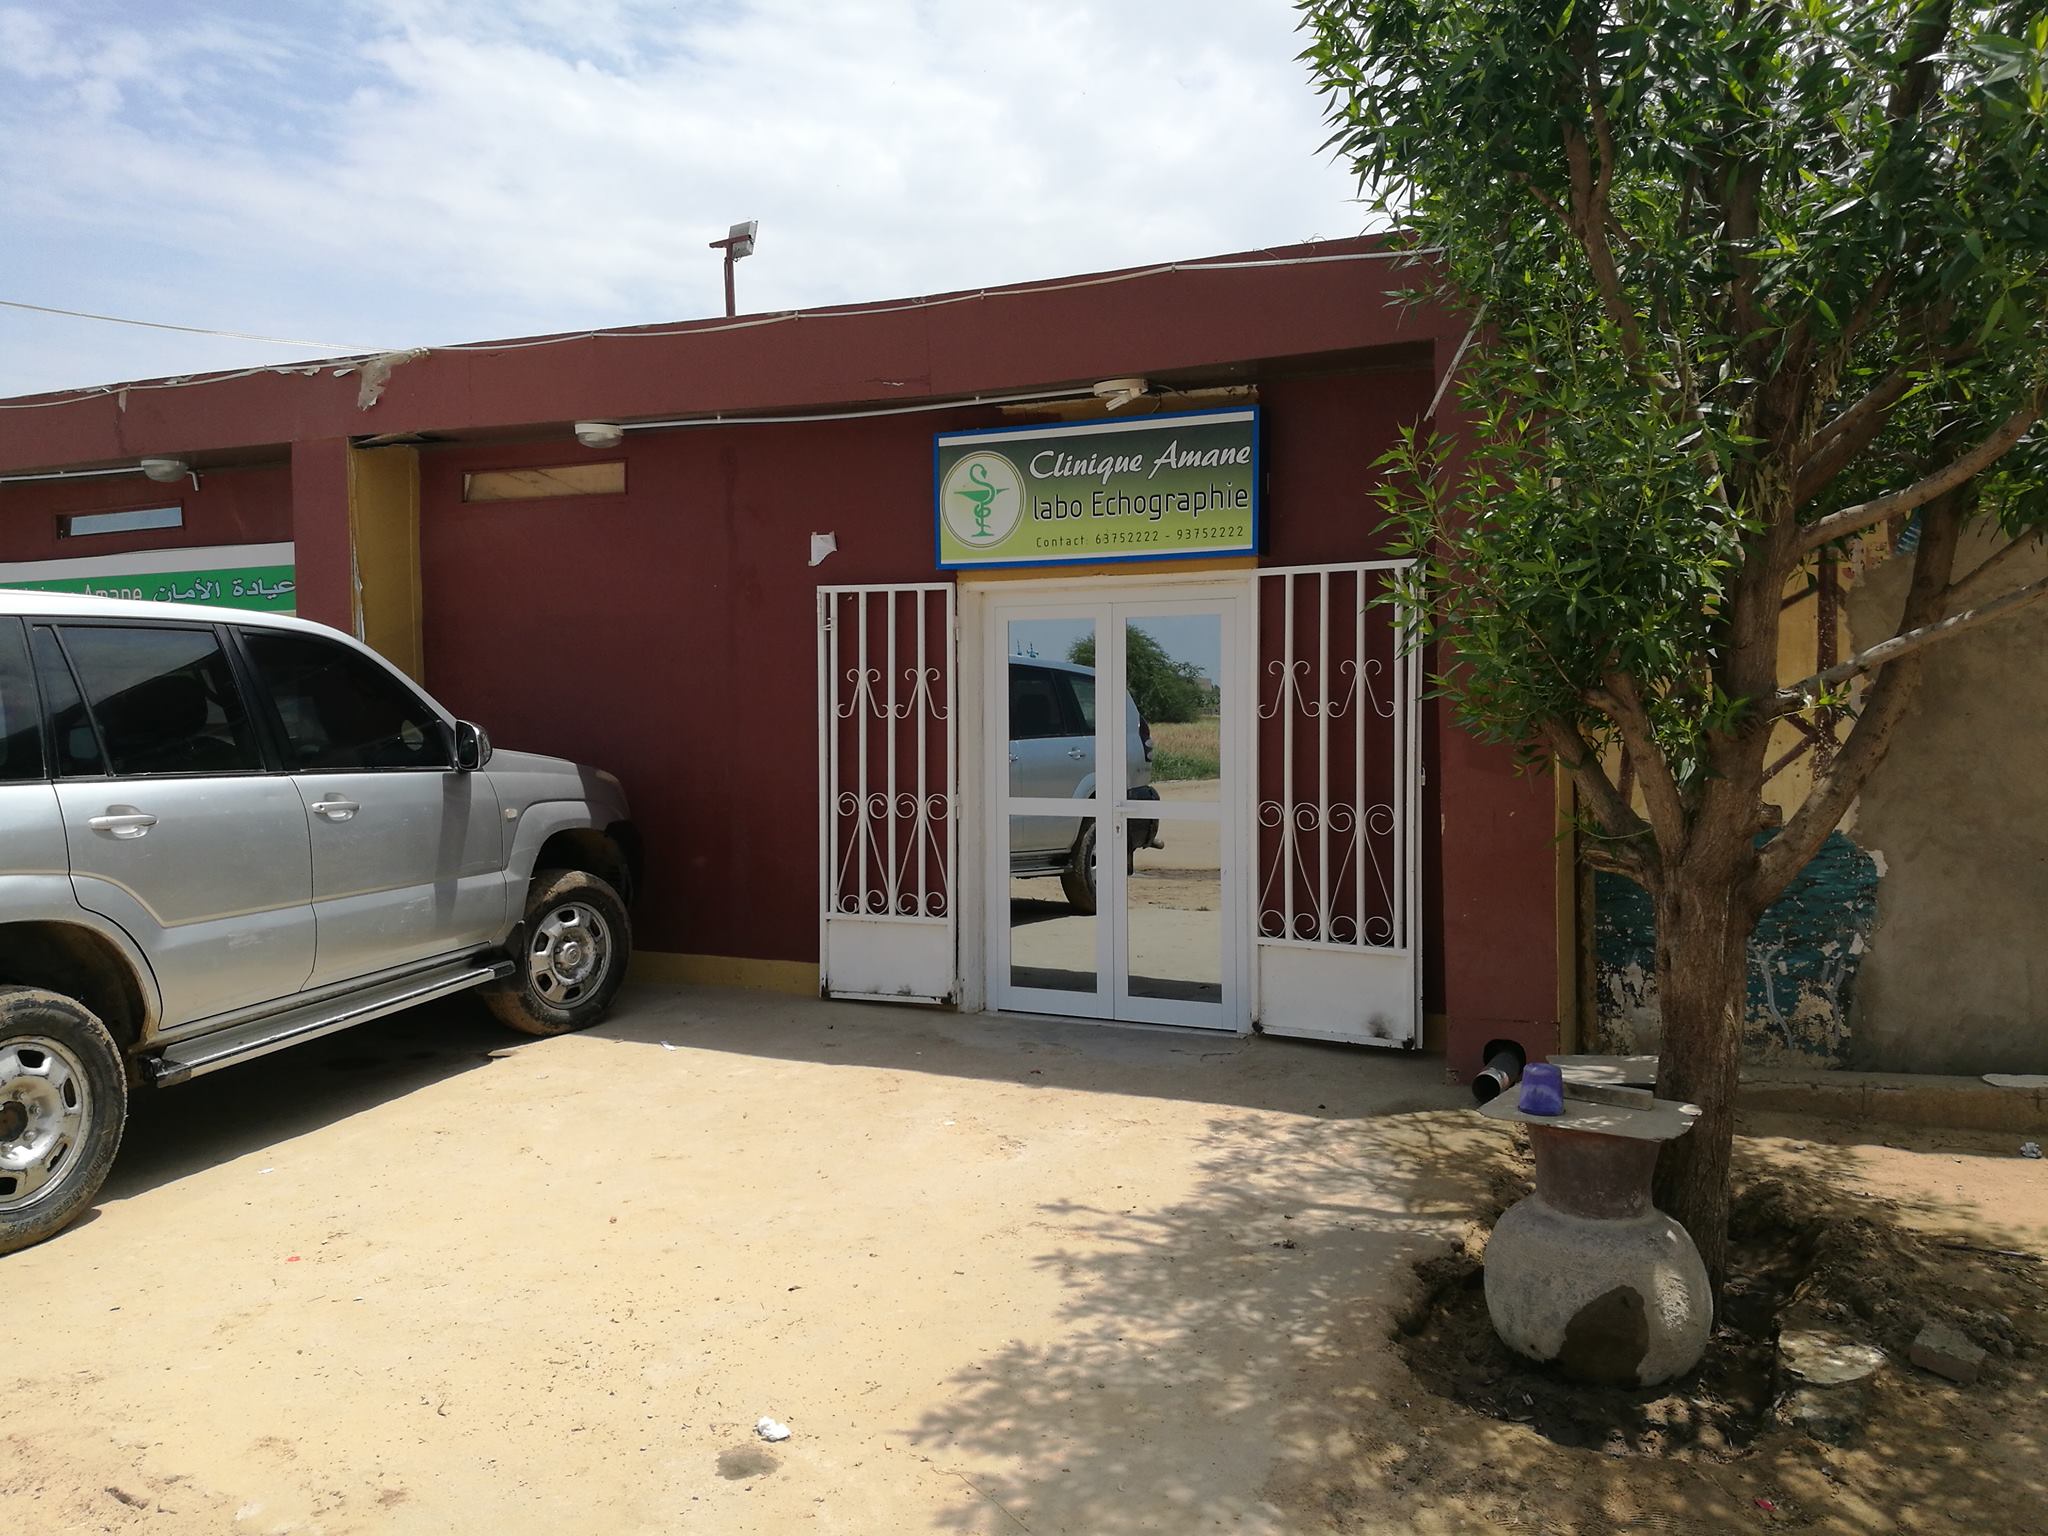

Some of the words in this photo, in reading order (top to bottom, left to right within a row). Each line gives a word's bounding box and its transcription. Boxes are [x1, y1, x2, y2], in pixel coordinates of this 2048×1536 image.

[1029, 450, 1143, 485] Clinique
[1148, 439, 1251, 479] Amane
[1033, 494, 1083, 521] labo
[1091, 482, 1249, 522] Echographie
[1095, 531, 1159, 545] 63752222
[1176, 525, 1243, 540] 93752222
[231, 577, 296, 599] عيادة
